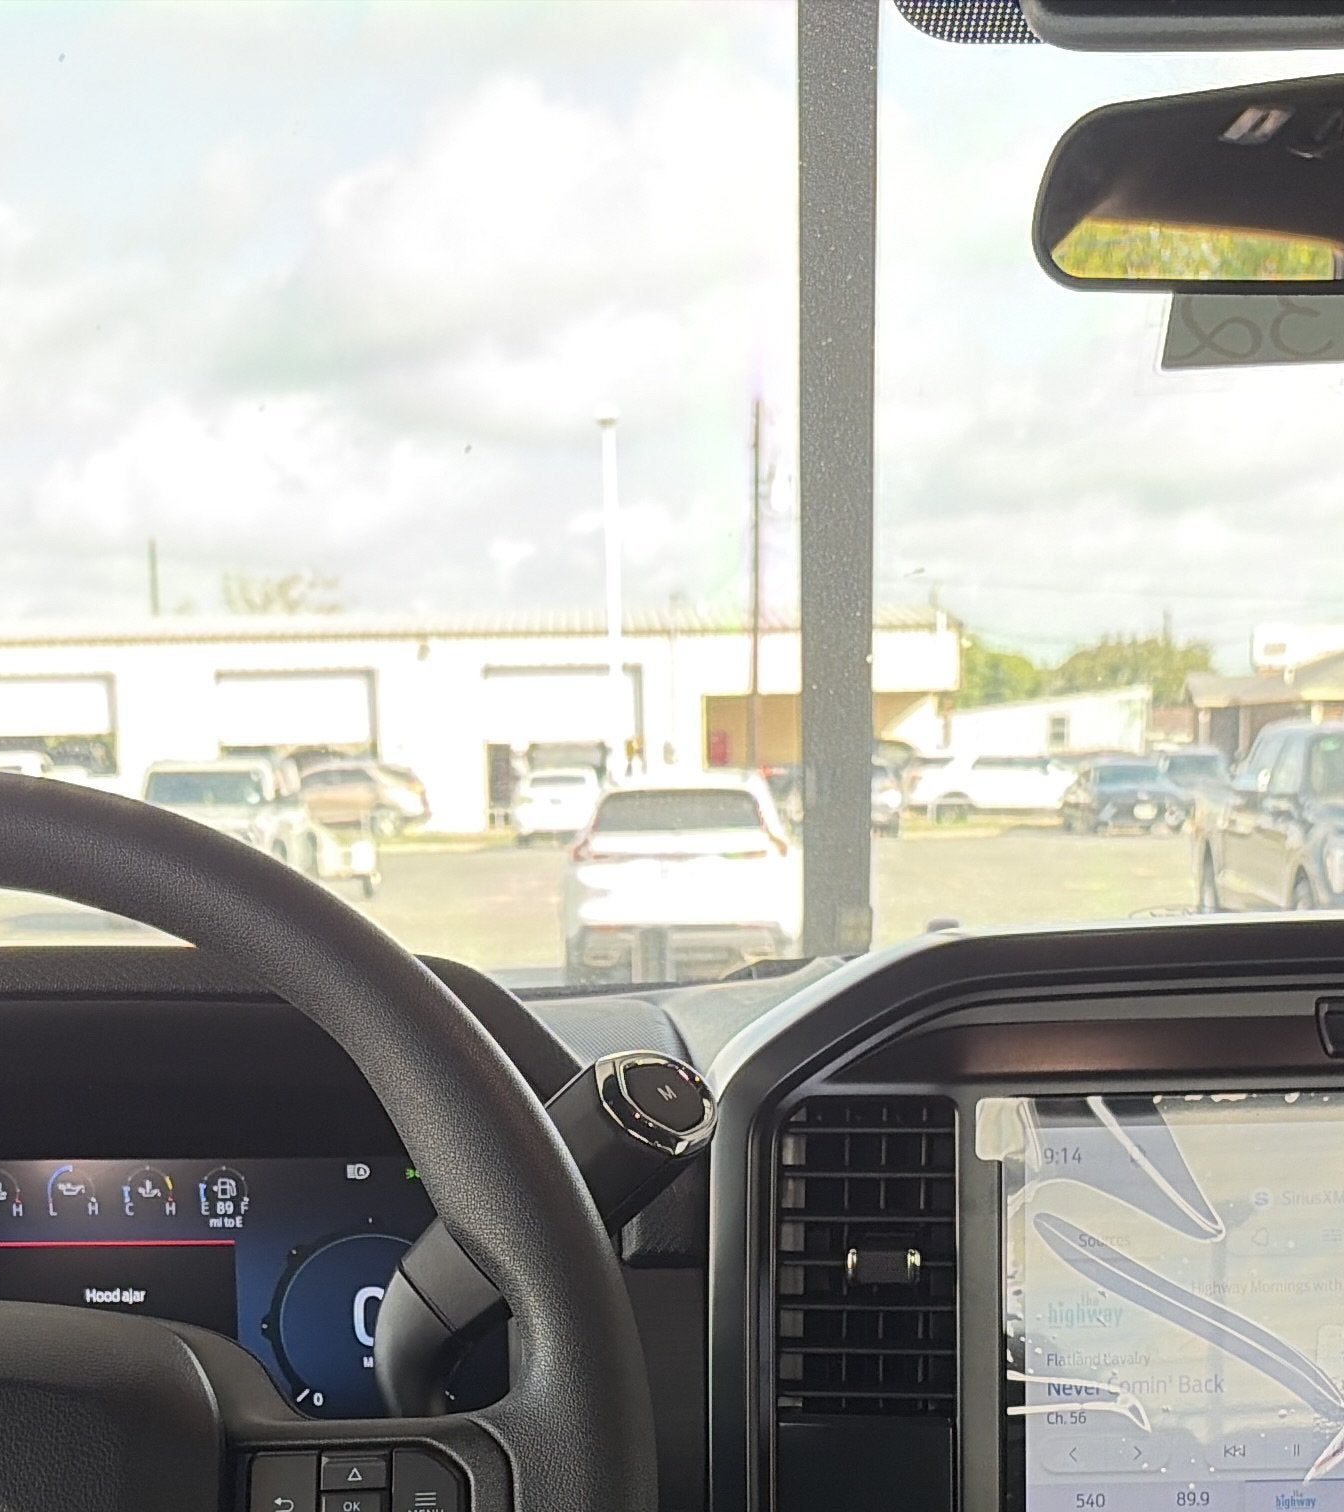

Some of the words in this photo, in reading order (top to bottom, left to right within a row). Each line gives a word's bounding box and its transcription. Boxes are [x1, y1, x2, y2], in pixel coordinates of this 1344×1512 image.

[1042, 1146, 1082, 1167] 9:14
[216, 1200, 234, 1215] 89
[1078, 1233, 1131, 1247] Sources
[1191, 1279, 1248, 1297] Highway
[1250, 1278, 1310, 1296] Mornings
[1312, 1278, 1342, 1293] with
[85, 1288, 121, 1303] Hood
[121, 1288, 146, 1305] ajar
[1048, 1302, 1123, 1327] highway
[1046, 1353, 1101, 1367] Flatland
[1178, 1374, 1225, 1395] Back
[1046, 1412, 1068, 1425] Ch.
[1070, 1411, 1087, 1425] 56
[342, 1501, 361, 1512] OK
[1075, 1494, 1106, 1509] 540
[1176, 1491, 1210, 1507] 89.9
